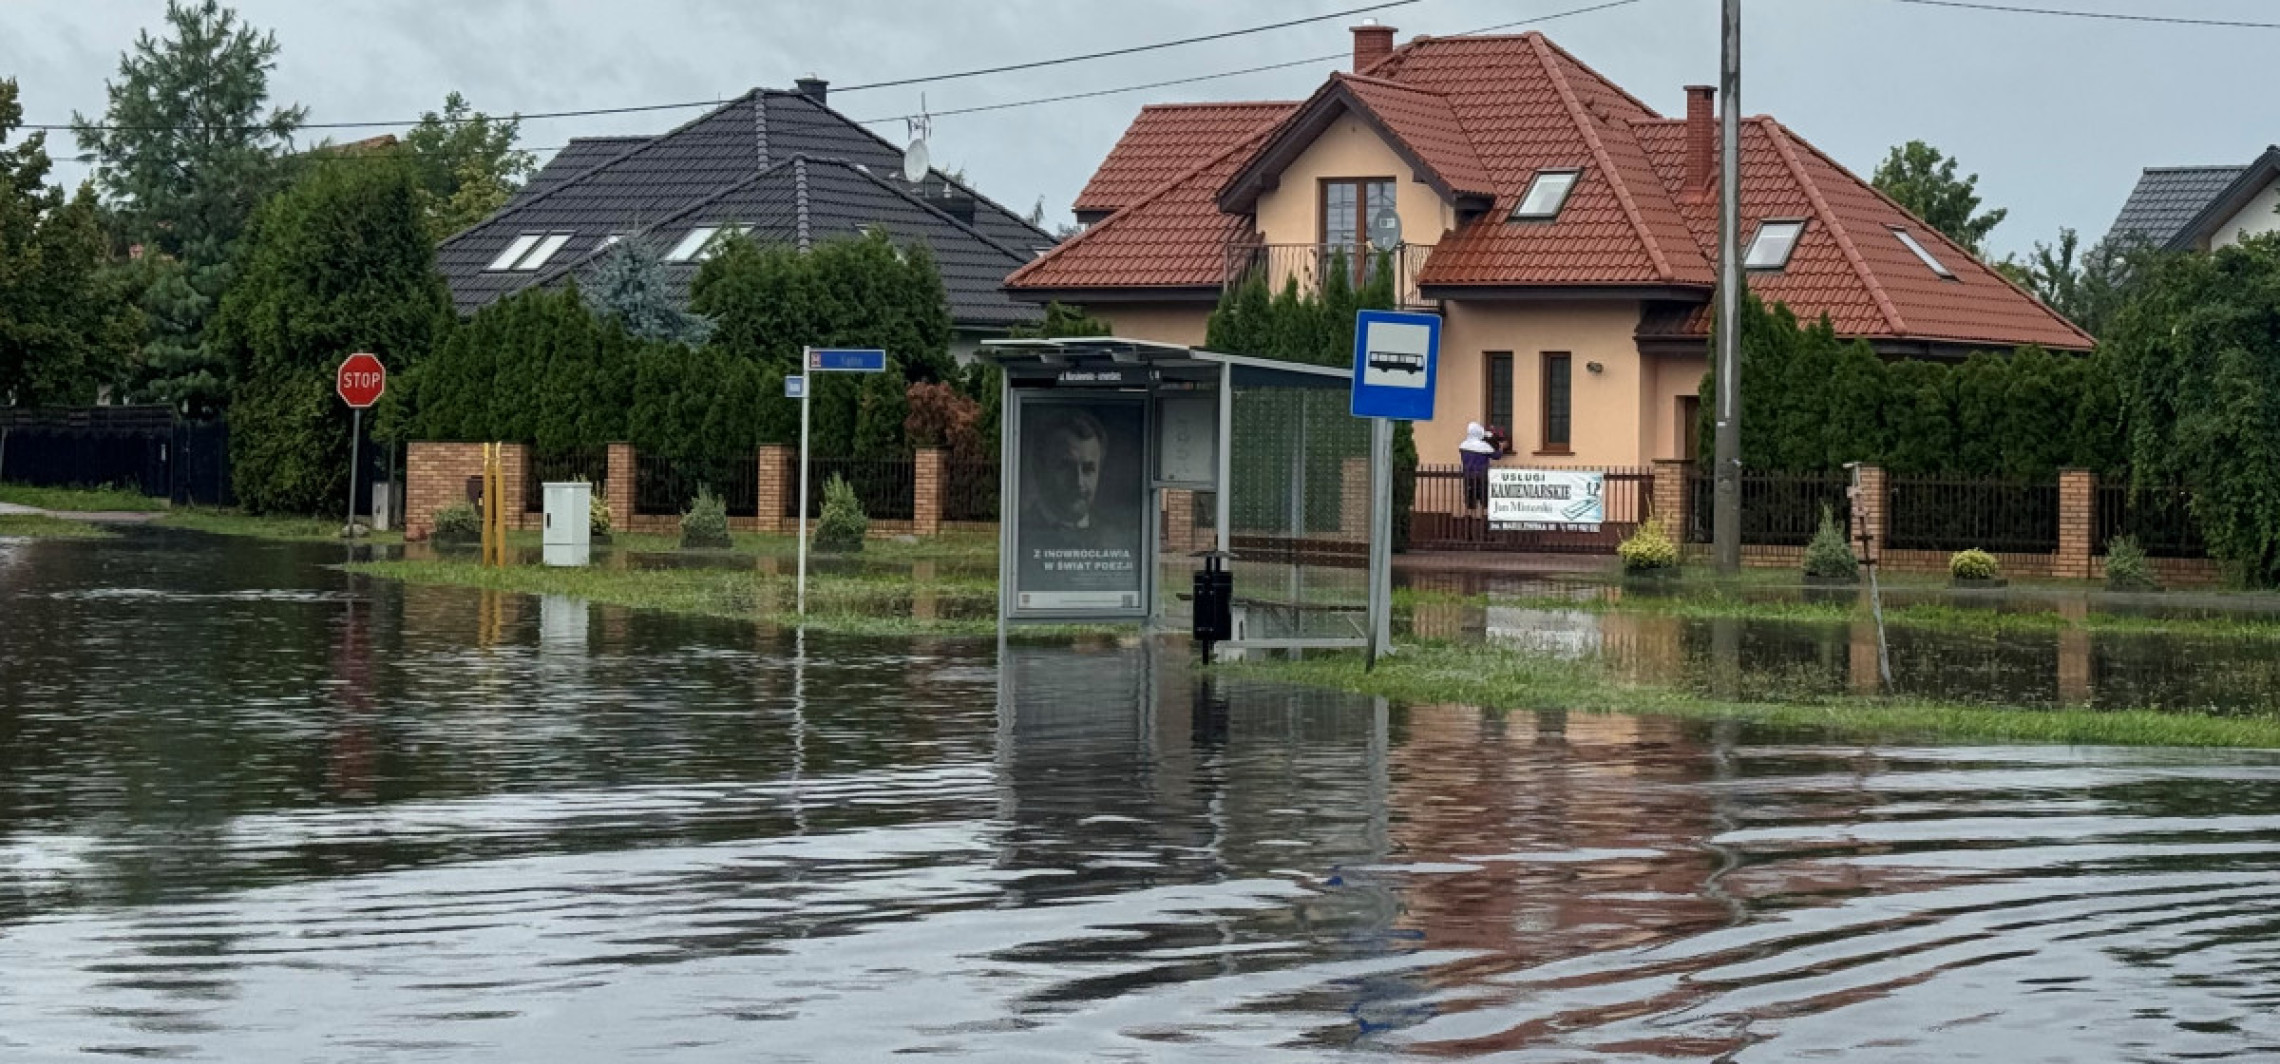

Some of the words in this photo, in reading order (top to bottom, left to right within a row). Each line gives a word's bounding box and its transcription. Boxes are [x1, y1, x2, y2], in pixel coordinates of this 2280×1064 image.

[343, 371, 381, 389] STOP
[1490, 483, 1572, 501] KAMIENIARSKIE
[1033, 549, 1041, 559] Z
[1044, 561, 1054, 571] W
